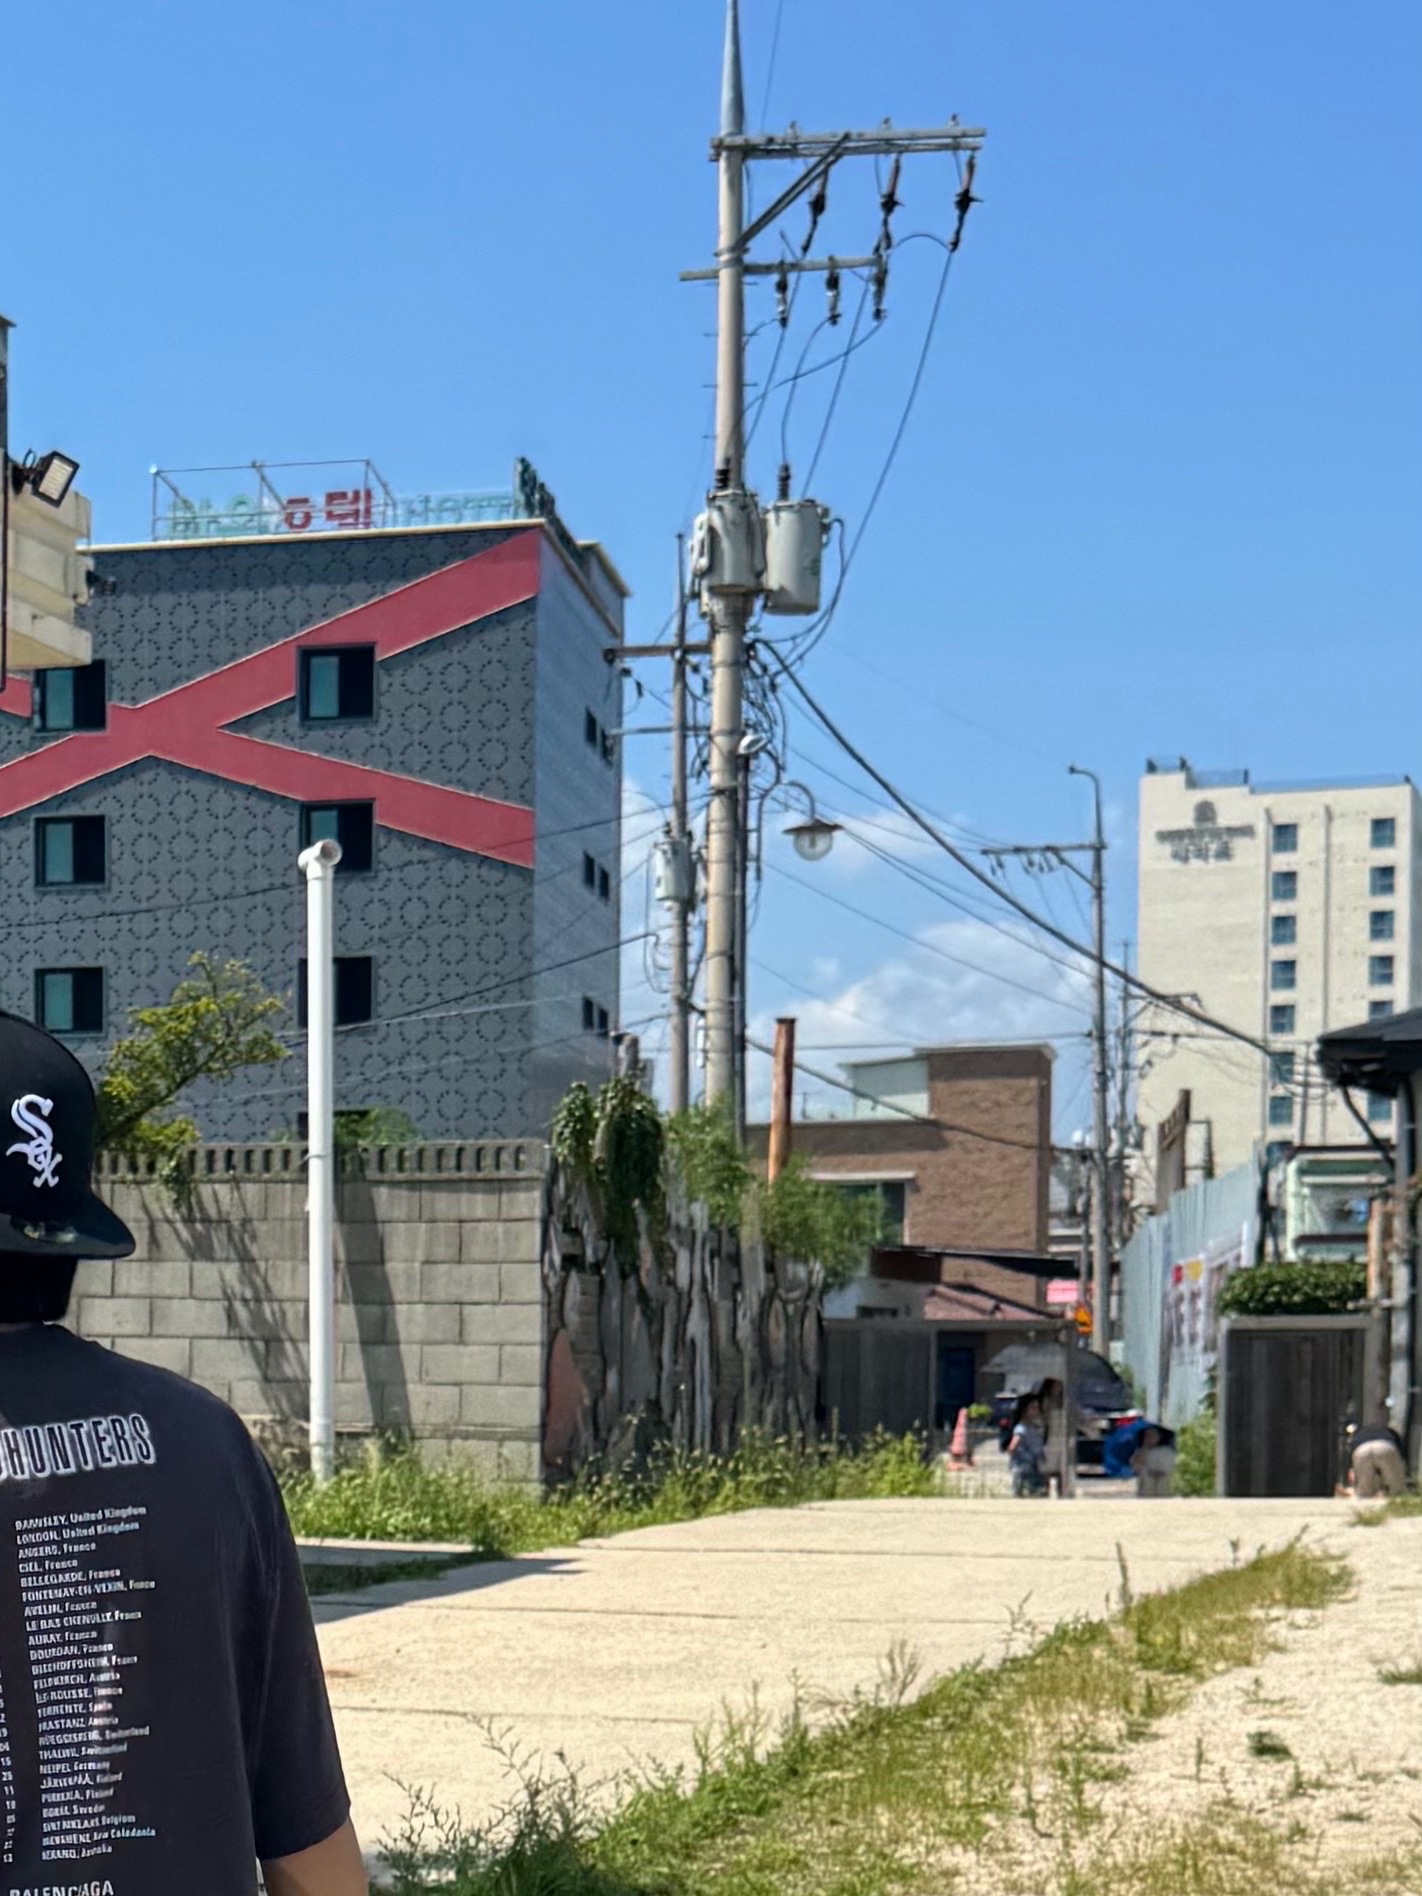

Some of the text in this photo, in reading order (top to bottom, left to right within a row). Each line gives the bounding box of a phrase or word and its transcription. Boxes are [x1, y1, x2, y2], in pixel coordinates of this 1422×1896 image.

[6, 1094, 63, 1188] Sox
[69, 1510, 103, 1523] United
[104, 1505, 147, 1519] Kingdom
[62, 1526, 95, 1539] United
[96, 1521, 139, 1535] Kingdom
[63, 1542, 96, 1554] France
[45, 1559, 78, 1570] France
[88, 1569, 121, 1580] France
[65, 1601, 97, 1612] France
